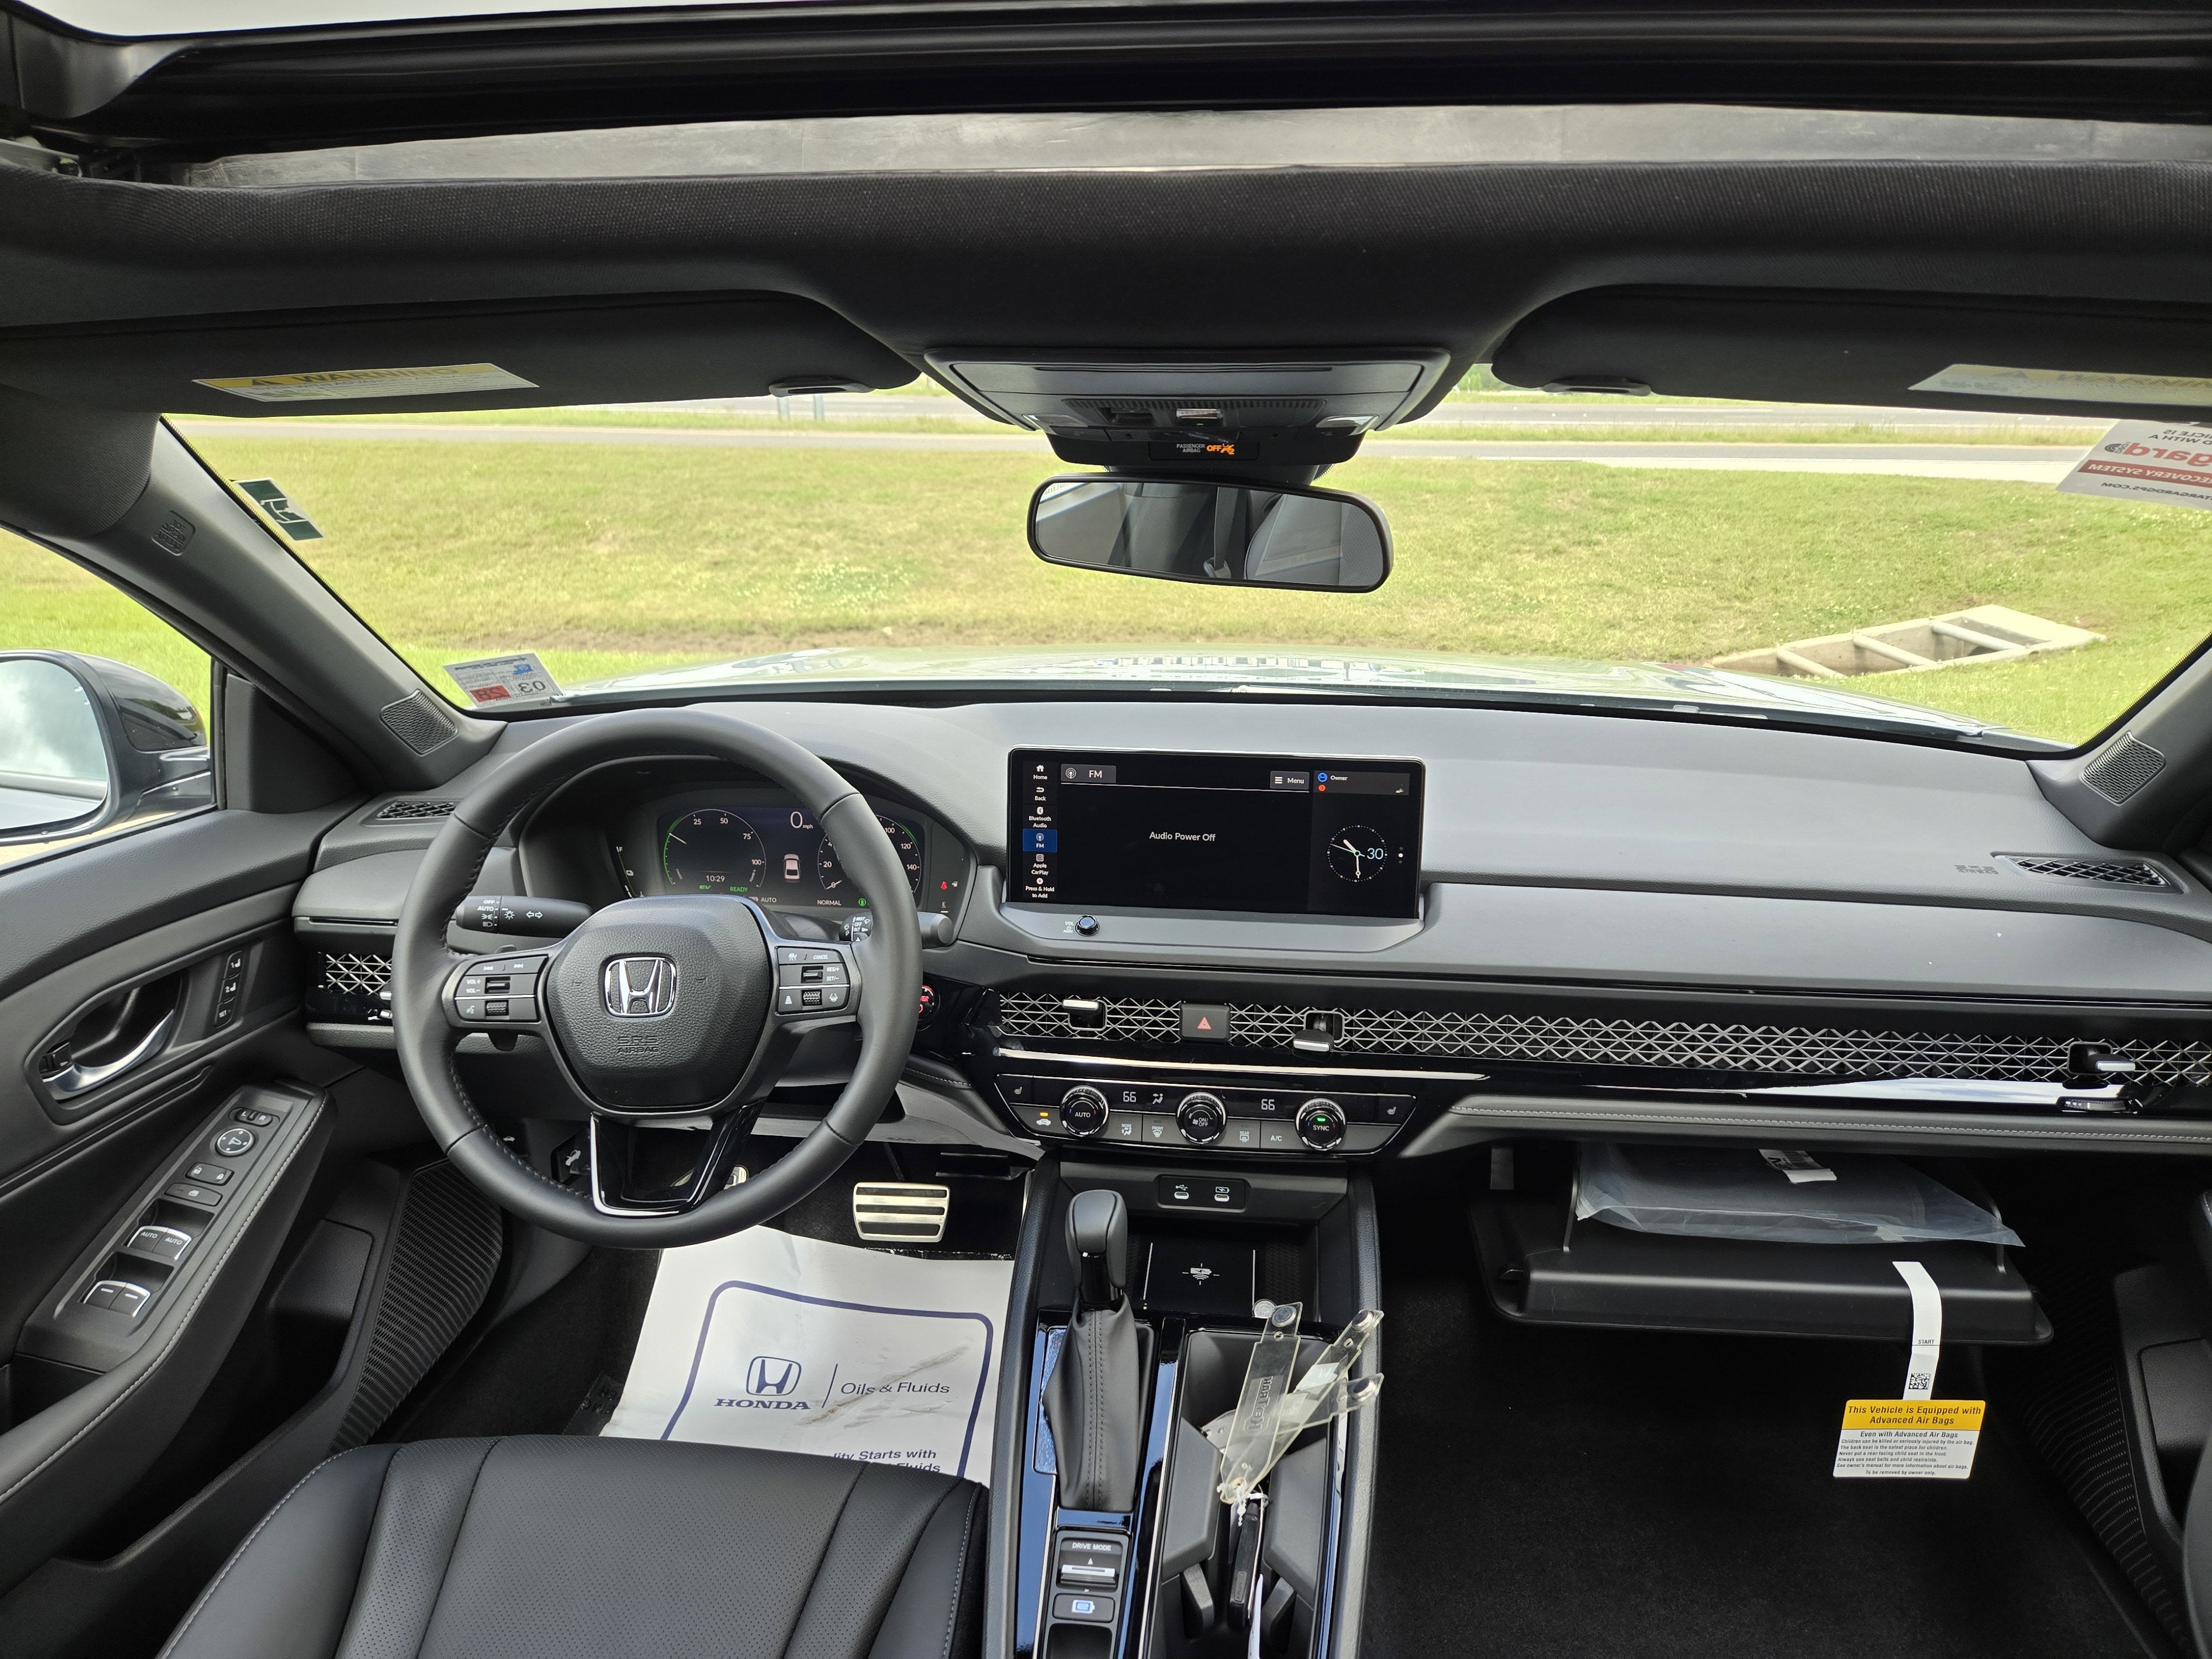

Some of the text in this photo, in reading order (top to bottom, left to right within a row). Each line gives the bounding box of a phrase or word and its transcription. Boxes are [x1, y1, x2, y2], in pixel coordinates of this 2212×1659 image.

[292, 368, 459, 382] WARNING
[790, 811, 802, 828] 0
[1149, 831, 1216, 842] Audio Power Off
[1366, 848, 1384, 860] 30
[1123, 1091, 1136, 1103] 66
[1261, 1098, 1275, 1111] 66
[140, 1231, 158, 1239] AUTO
[165, 1237, 183, 1245] AUTO
[841, 1381, 951, 1396] Oils & Fluids
[713, 1398, 811, 1410] HONDA
[1870, 1406, 1903, 1414] Vehicle
[1917, 1406, 1959, 1415] Equipped
[1962, 1406, 1981, 1415] with
[1932, 1417, 1955, 1426] Bags
[858, 1449, 937, 1460] Starts with
